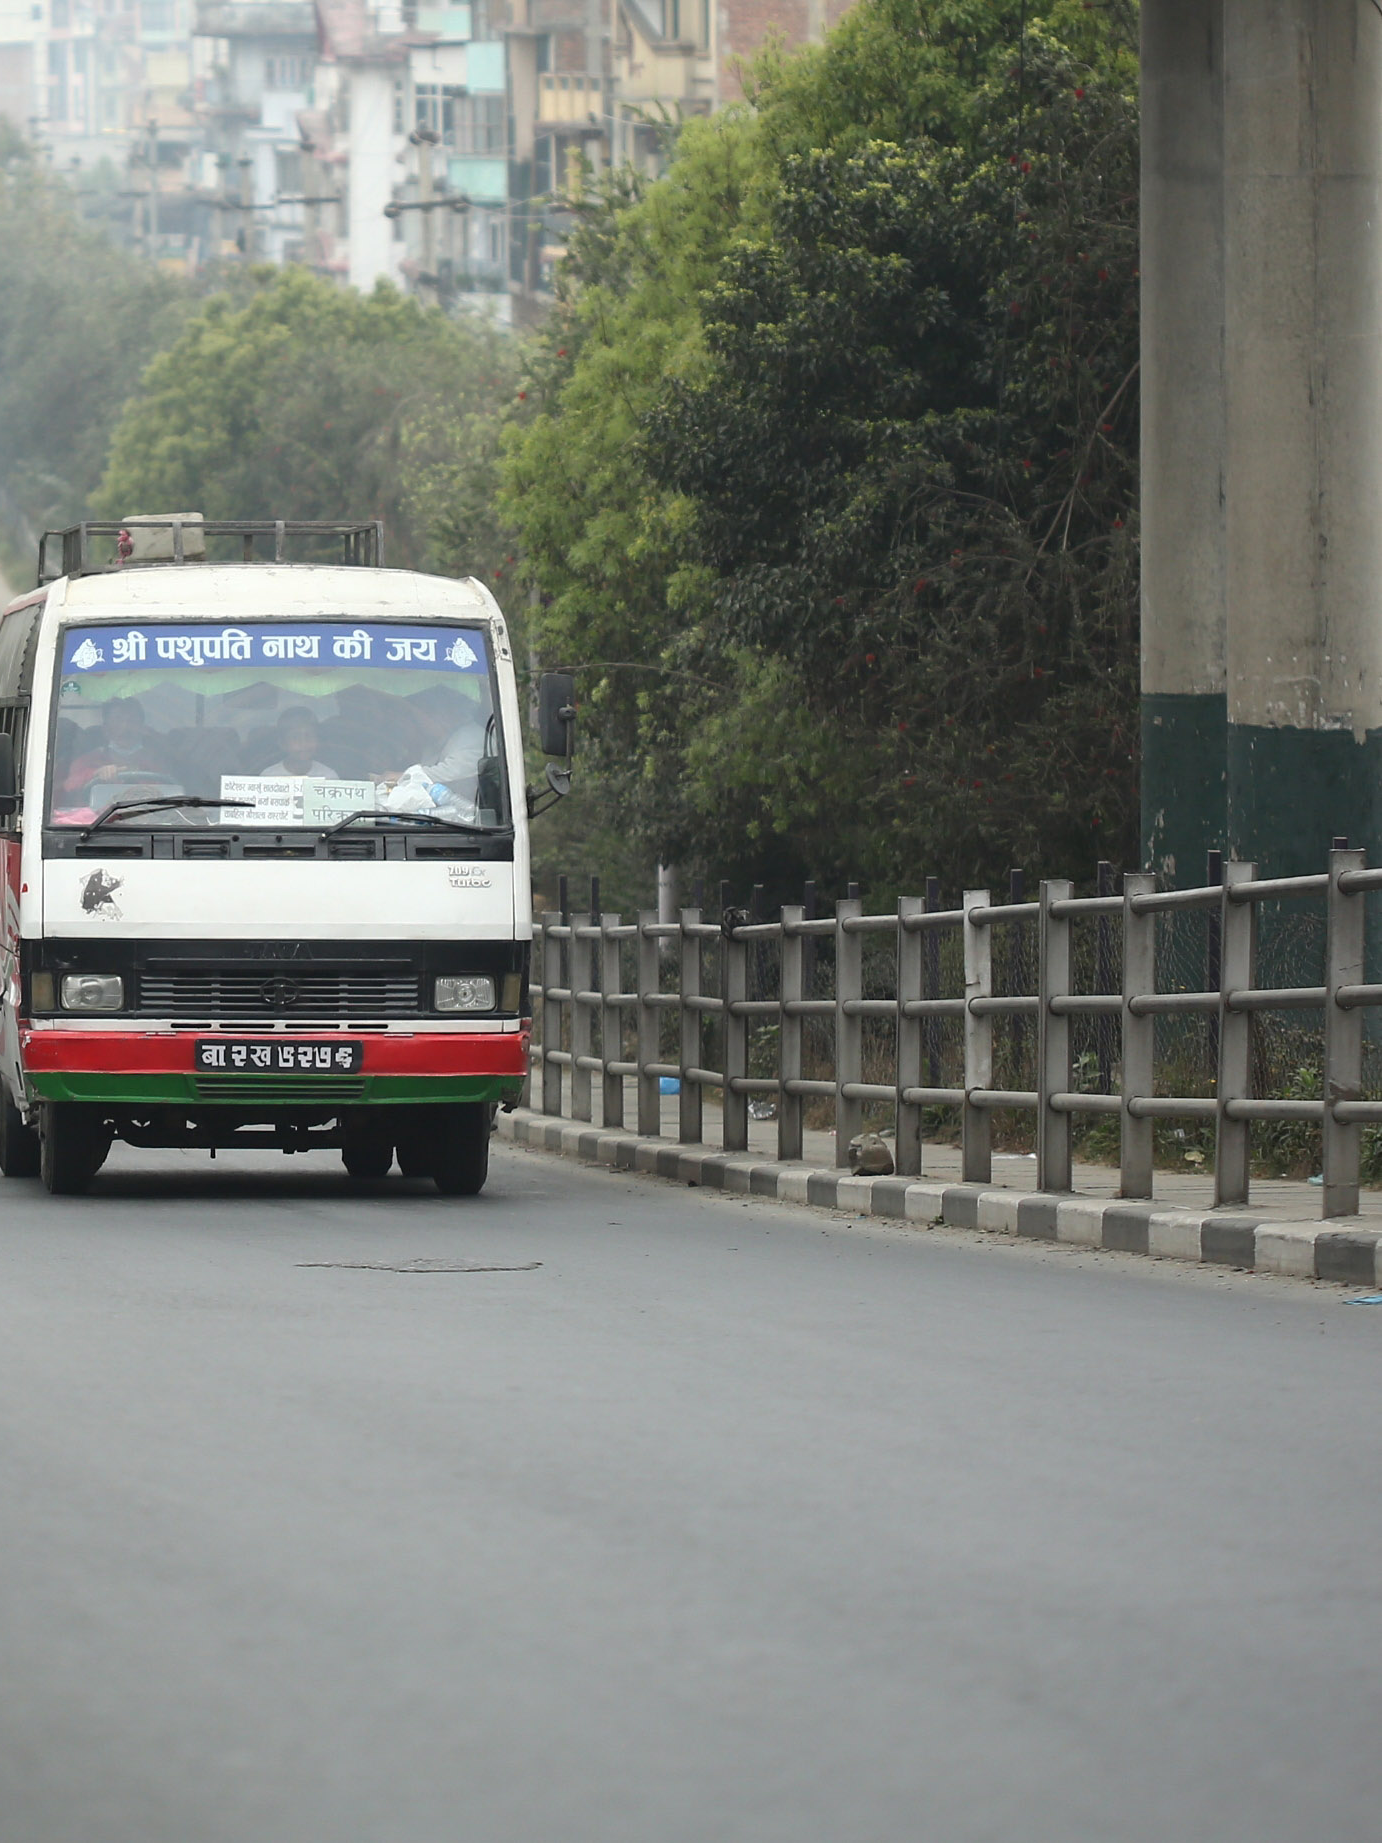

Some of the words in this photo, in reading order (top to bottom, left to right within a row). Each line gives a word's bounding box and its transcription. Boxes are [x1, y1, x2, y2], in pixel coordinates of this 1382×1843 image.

[112, 631, 148, 663] श्री
[155, 628, 254, 666] पशुपति
[261, 635, 321, 659] नाथ
[333, 629, 373, 660] की
[385, 637, 437, 662] जय
[312, 785, 367, 800] चक्रपथ
[202, 1045, 226, 1067] बा
